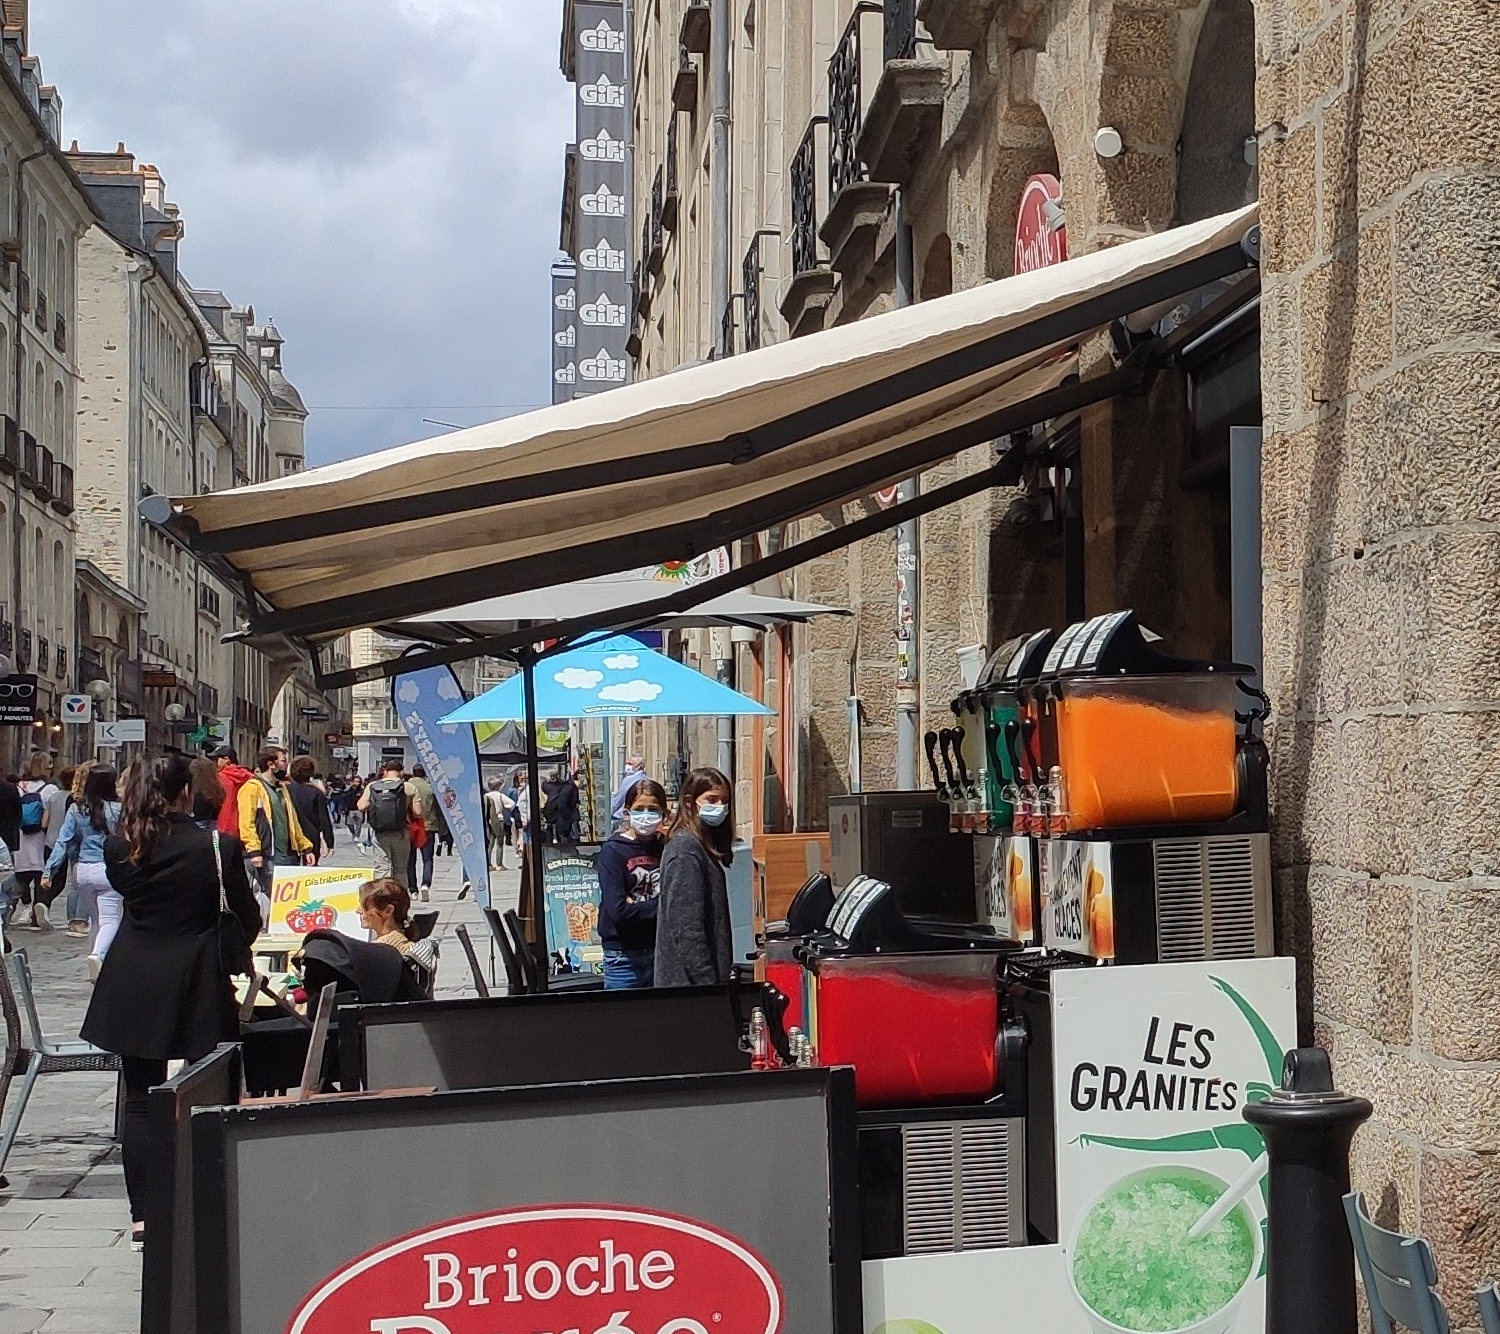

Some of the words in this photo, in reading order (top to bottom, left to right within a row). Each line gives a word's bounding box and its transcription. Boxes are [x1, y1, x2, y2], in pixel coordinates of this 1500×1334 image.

[273, 880, 301, 904] ICI
[1143, 1016, 1215, 1070] LES
[422, 1238, 676, 1310] Brioche
